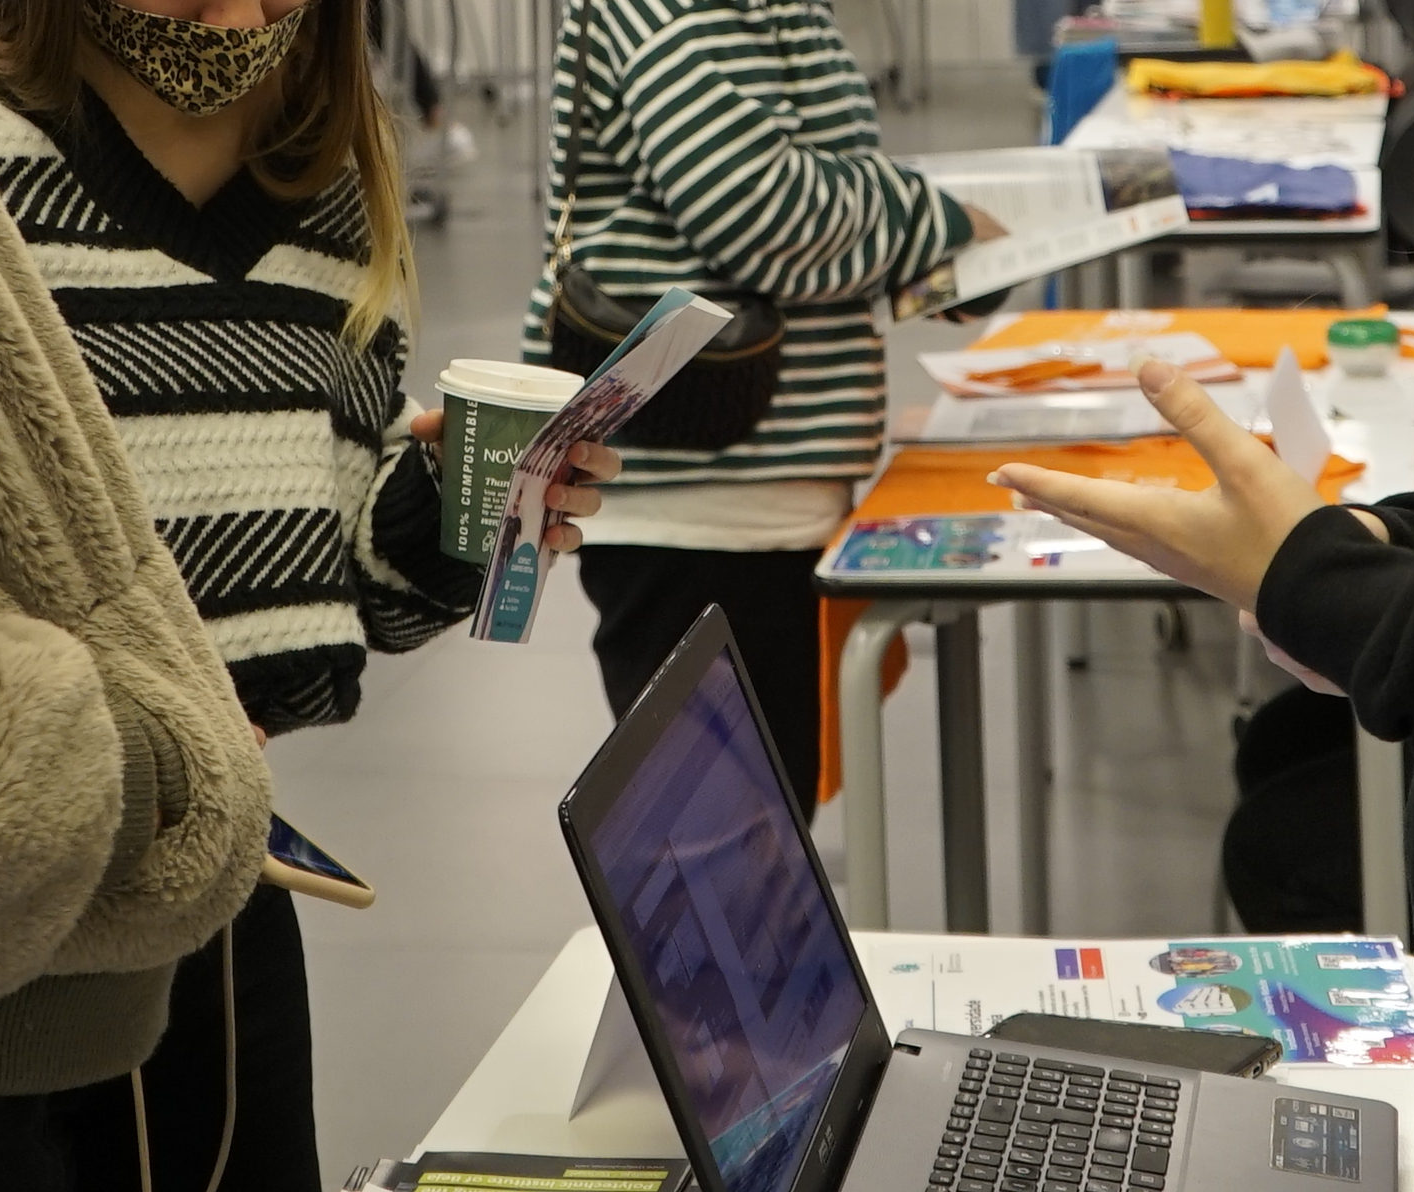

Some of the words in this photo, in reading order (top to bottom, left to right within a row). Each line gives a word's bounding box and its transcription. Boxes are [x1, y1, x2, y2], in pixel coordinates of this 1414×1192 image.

[461, 399, 479, 506] COMPOSTABLE
[483, 447, 524, 465] NOV
[485, 477, 510, 488] Than
[458, 512, 470, 552] 100%
